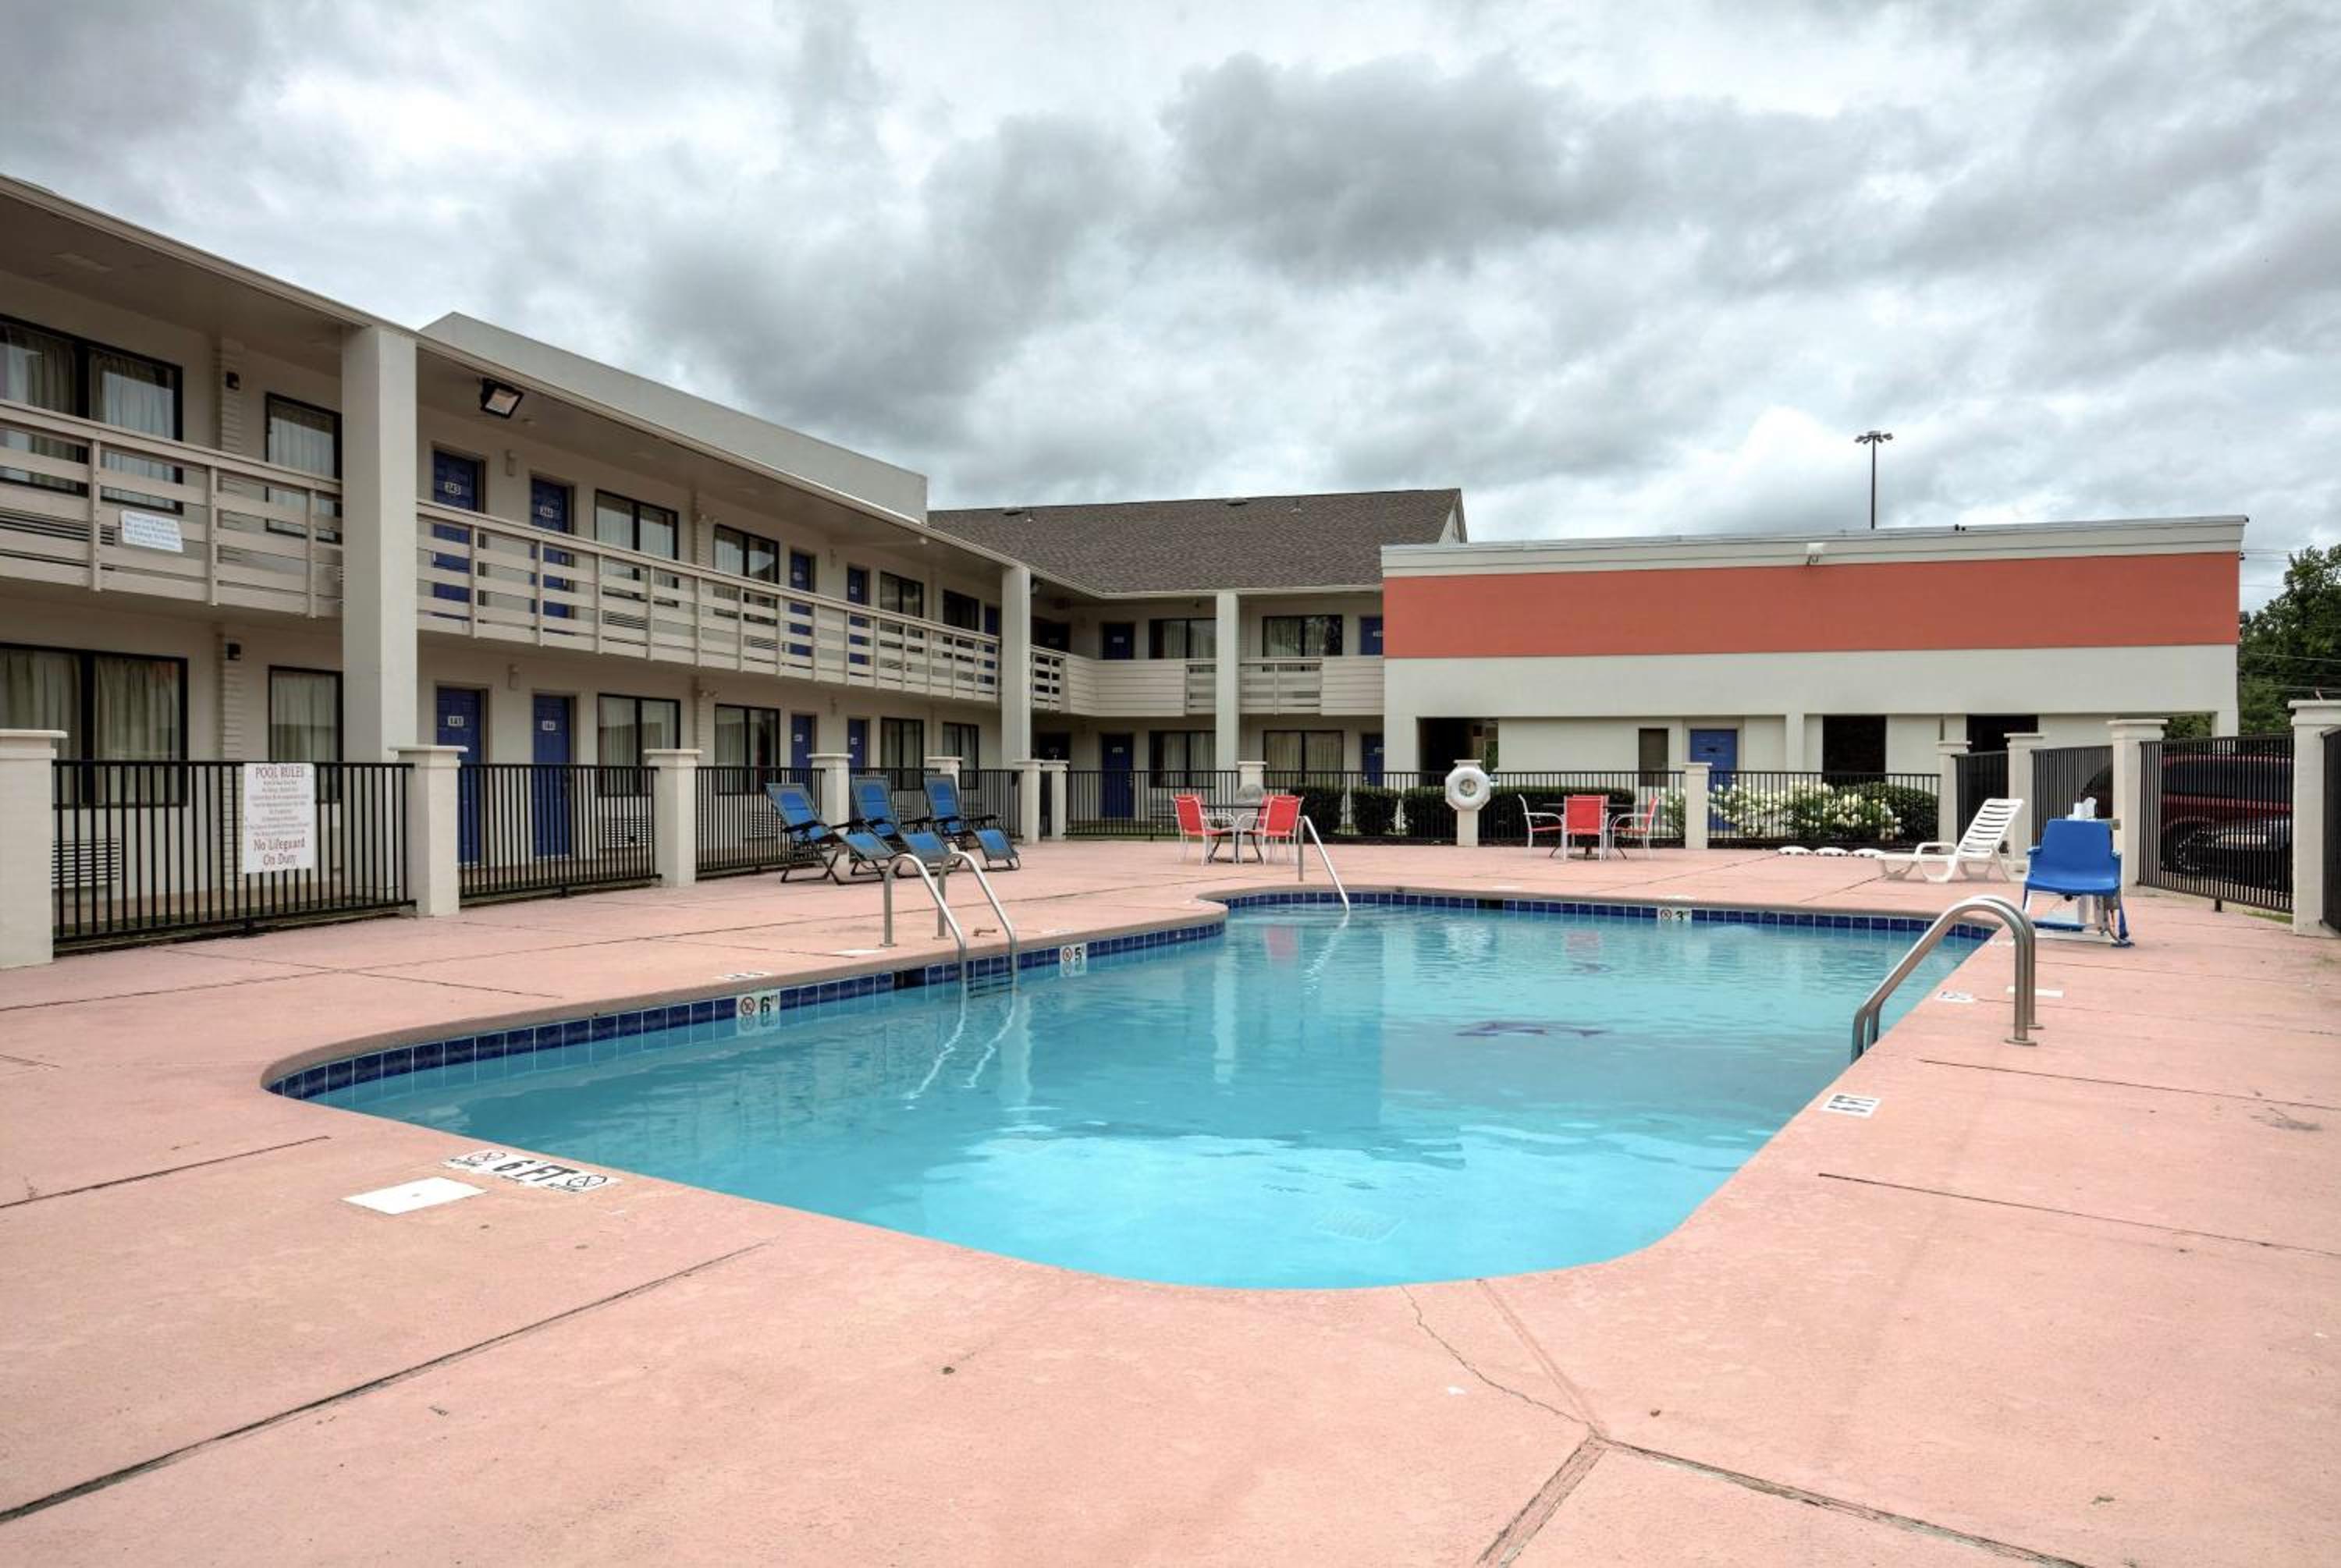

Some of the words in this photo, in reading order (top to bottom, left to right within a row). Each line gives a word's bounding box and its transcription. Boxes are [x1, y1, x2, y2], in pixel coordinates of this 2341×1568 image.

[255, 766, 279, 779] POOL
[254, 839, 266, 852] No
[268, 836, 306, 853] Lifeguard
[263, 854, 275, 866] On
[278, 853, 297, 867] Duty
